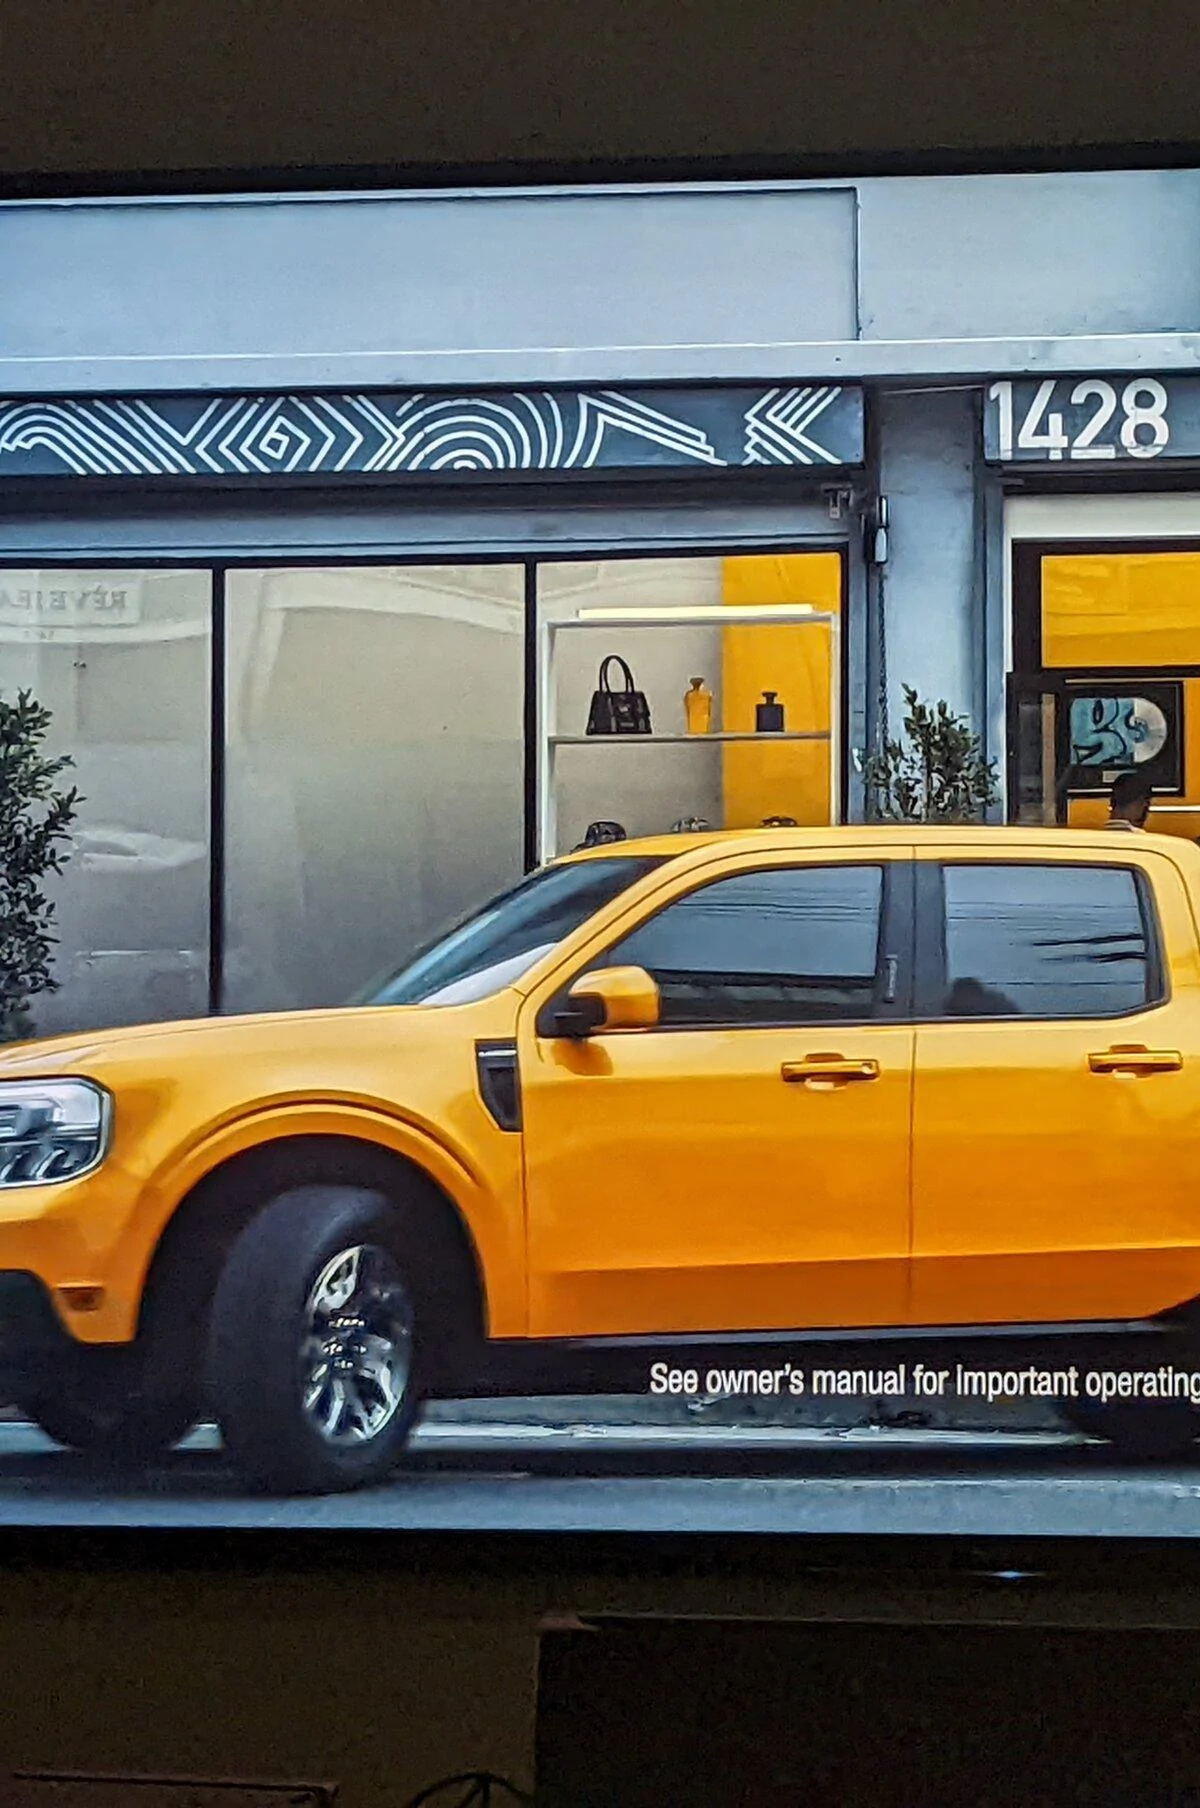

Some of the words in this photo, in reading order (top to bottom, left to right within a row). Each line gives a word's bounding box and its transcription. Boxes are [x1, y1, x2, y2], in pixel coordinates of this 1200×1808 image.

[988, 377, 1169, 459] 1428
[649, 1362, 698, 1394] See
[705, 1363, 805, 1395] owner's
[811, 1363, 906, 1396] manual
[912, 1363, 950, 1396] for
[956, 1363, 1080, 1402] important
